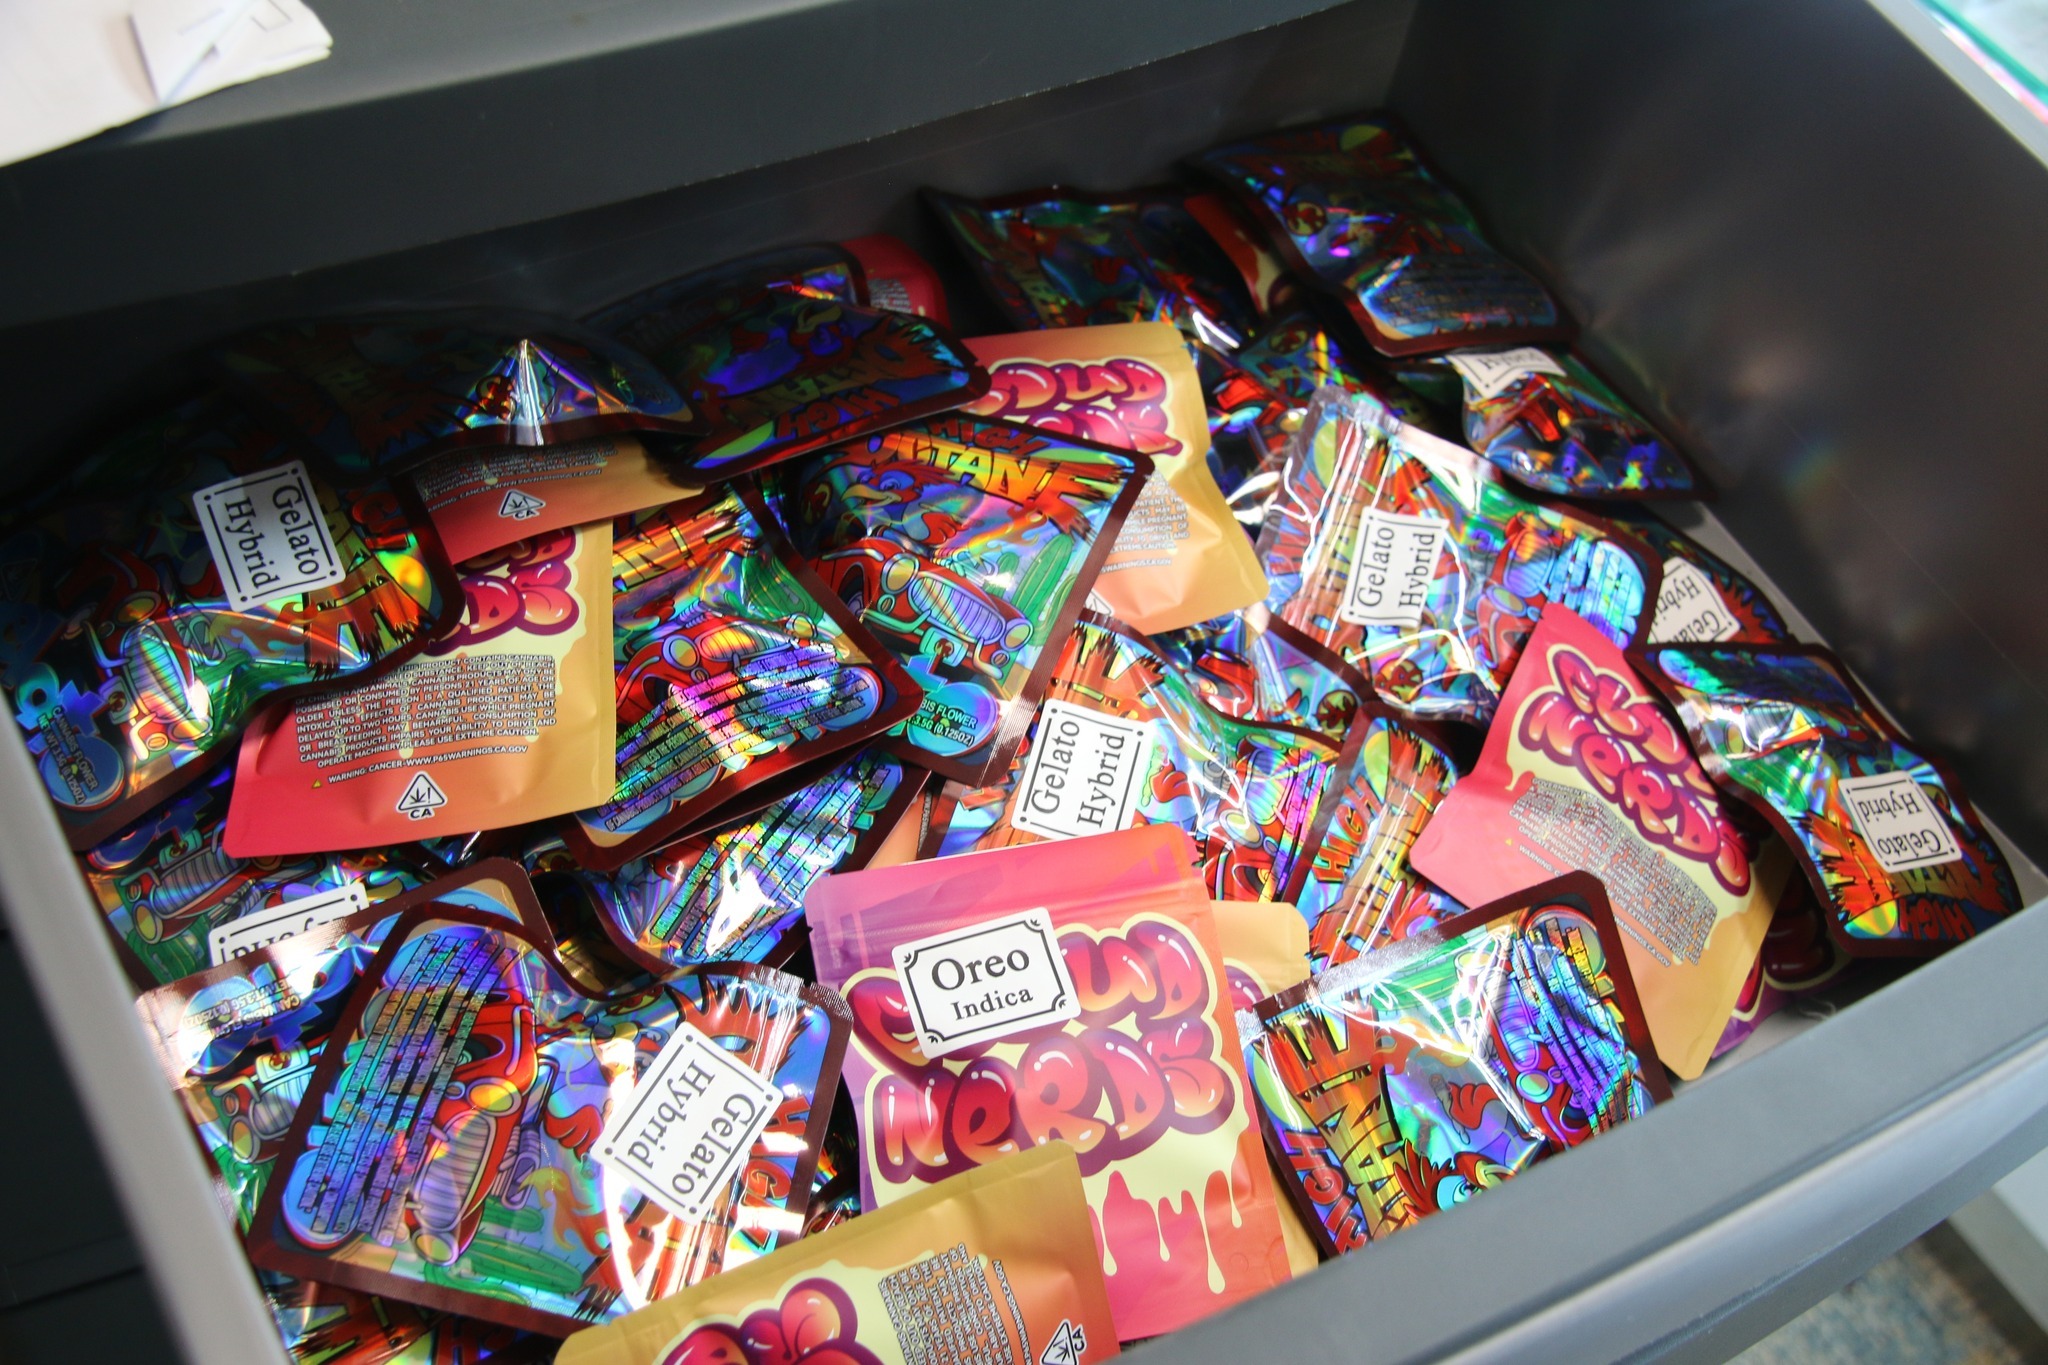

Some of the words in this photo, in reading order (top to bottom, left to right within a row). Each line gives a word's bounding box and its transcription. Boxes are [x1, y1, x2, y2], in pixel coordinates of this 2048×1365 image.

[929, 418, 1048, 456] HIGH
[272, 485, 320, 576] Gelato
[515, 511, 537, 519] CA
[224, 497, 280, 589] Hybrid
[1356, 527, 1395, 607] Gelato
[1398, 532, 1435, 608] Hybrid
[1672, 607, 1721, 643] Gela
[456, 670, 504, 680] PRODUCTS
[464, 655, 506, 664] CONTAINS
[467, 662, 489, 671] KEEP
[490, 661, 508, 669] OUT
[295, 700, 342, 715] POSSESSED
[344, 695, 358, 705] OR
[360, 688, 409, 703] CONSUMED
[423, 682, 463, 692] PERSONS
[478, 678, 506, 686] YEARS
[508, 676, 520, 684] OF
[296, 712, 324, 724] OLDER
[328, 706, 362, 717] UNLESS
[365, 701, 381, 711] THE
[385, 696, 419, 706] PERSON
[447, 687, 493, 699] QUALIFIED
[297, 716, 355, 734] INTOXICATING
[360, 708, 394, 722] EFFECTS
[399, 705, 412, 713] OF
[417, 699, 461, 711] CANNABIS
[467, 694, 514, 704] PRODUCTS
[519, 692, 538, 700] MAY
[297, 730, 337, 743] DELAYED
[337, 727, 348, 735] UP
[349, 724, 360, 732] TO
[362, 720, 381, 730] TWO
[416, 706, 459, 720] CANNABIS
[461, 705, 477, 713] USE
[480, 703, 507, 711] WHILE
[509, 700, 555, 710] PREGNANT
[935, 703, 978, 730] FLOWER
[299, 743, 312, 753] OR
[318, 730, 382, 749] BREASTFEEDING
[387, 724, 406, 733] MAY
[473, 710, 537, 720] CONSUMPTION
[300, 747, 344, 762] CANNABIS
[345, 736, 387, 751] PRODUCTS
[390, 729, 425, 740] IMPAIRS
[428, 725, 452, 735] YOUR
[455, 722, 488, 732] ABILITY
[507, 719, 534, 727] DRIVE
[536, 718, 556, 726] AND
[53, 706, 79, 754] CANNABIS
[74, 750, 99, 791] FLOWER
[317, 754, 353, 769] OPERATE
[404, 736, 435, 749] PLEASE
[437, 734, 454, 744] USE
[455, 730, 495, 741] EXTREME
[328, 769, 367, 784] WARNING:
[1031, 720, 1080, 815] Gelato
[1076, 732, 1125, 829] Hybrid
[410, 809, 432, 819] CA
[1857, 789, 1923, 823] Hybrid
[1312, 775, 1384, 883] HIGH
[1517, 826, 1550, 849] OPERATE
[1877, 828, 1942, 858] Gelato
[1900, 896, 1978, 942] HIGH
[930, 947, 1030, 991] Oreo
[950, 987, 1034, 1021] Indica
[627, 1059, 715, 1169] Hybrid
[671, 1093, 756, 1195] Gelato
[930, 1256, 939, 1269] BE
[949, 1247, 957, 1260] OF
[958, 1243, 968, 1262] AND
[898, 1269, 908, 1282] BE
[909, 1265, 919, 1280] OR
[920, 1261, 931, 1280] THE
[937, 1274, 948, 1295] MAY
[940, 1252, 961, 1300] PREGNANT
[965, 1266, 978, 1293] DRIVE
[888, 1274, 905, 1307] REACH
[904, 1284, 916, 1304] ONY
[916, 1282, 927, 1302] AGE
[956, 1267, 982, 1334] CONSUMPTION
[976, 1298, 984, 1311] TO
[902, 1308, 911, 1322] OF
[912, 1304, 924, 1326] MAY
[924, 1302, 933, 1317] OF
[946, 1300, 966, 1350] PRODUCTS
[957, 1301, 971, 1332] WHILE
[988, 1301, 1006, 1344] EXTREME
[907, 1324, 919, 1344] OUT
[930, 1319, 943, 1349] YEARS
[968, 1334, 977, 1351] USE
[982, 1314, 998, 1349] ABILITY
[1070, 1328, 1086, 1350] CA
[941, 1351, 948, 1362] 21
[1003, 1345, 1013, 1362] USE
